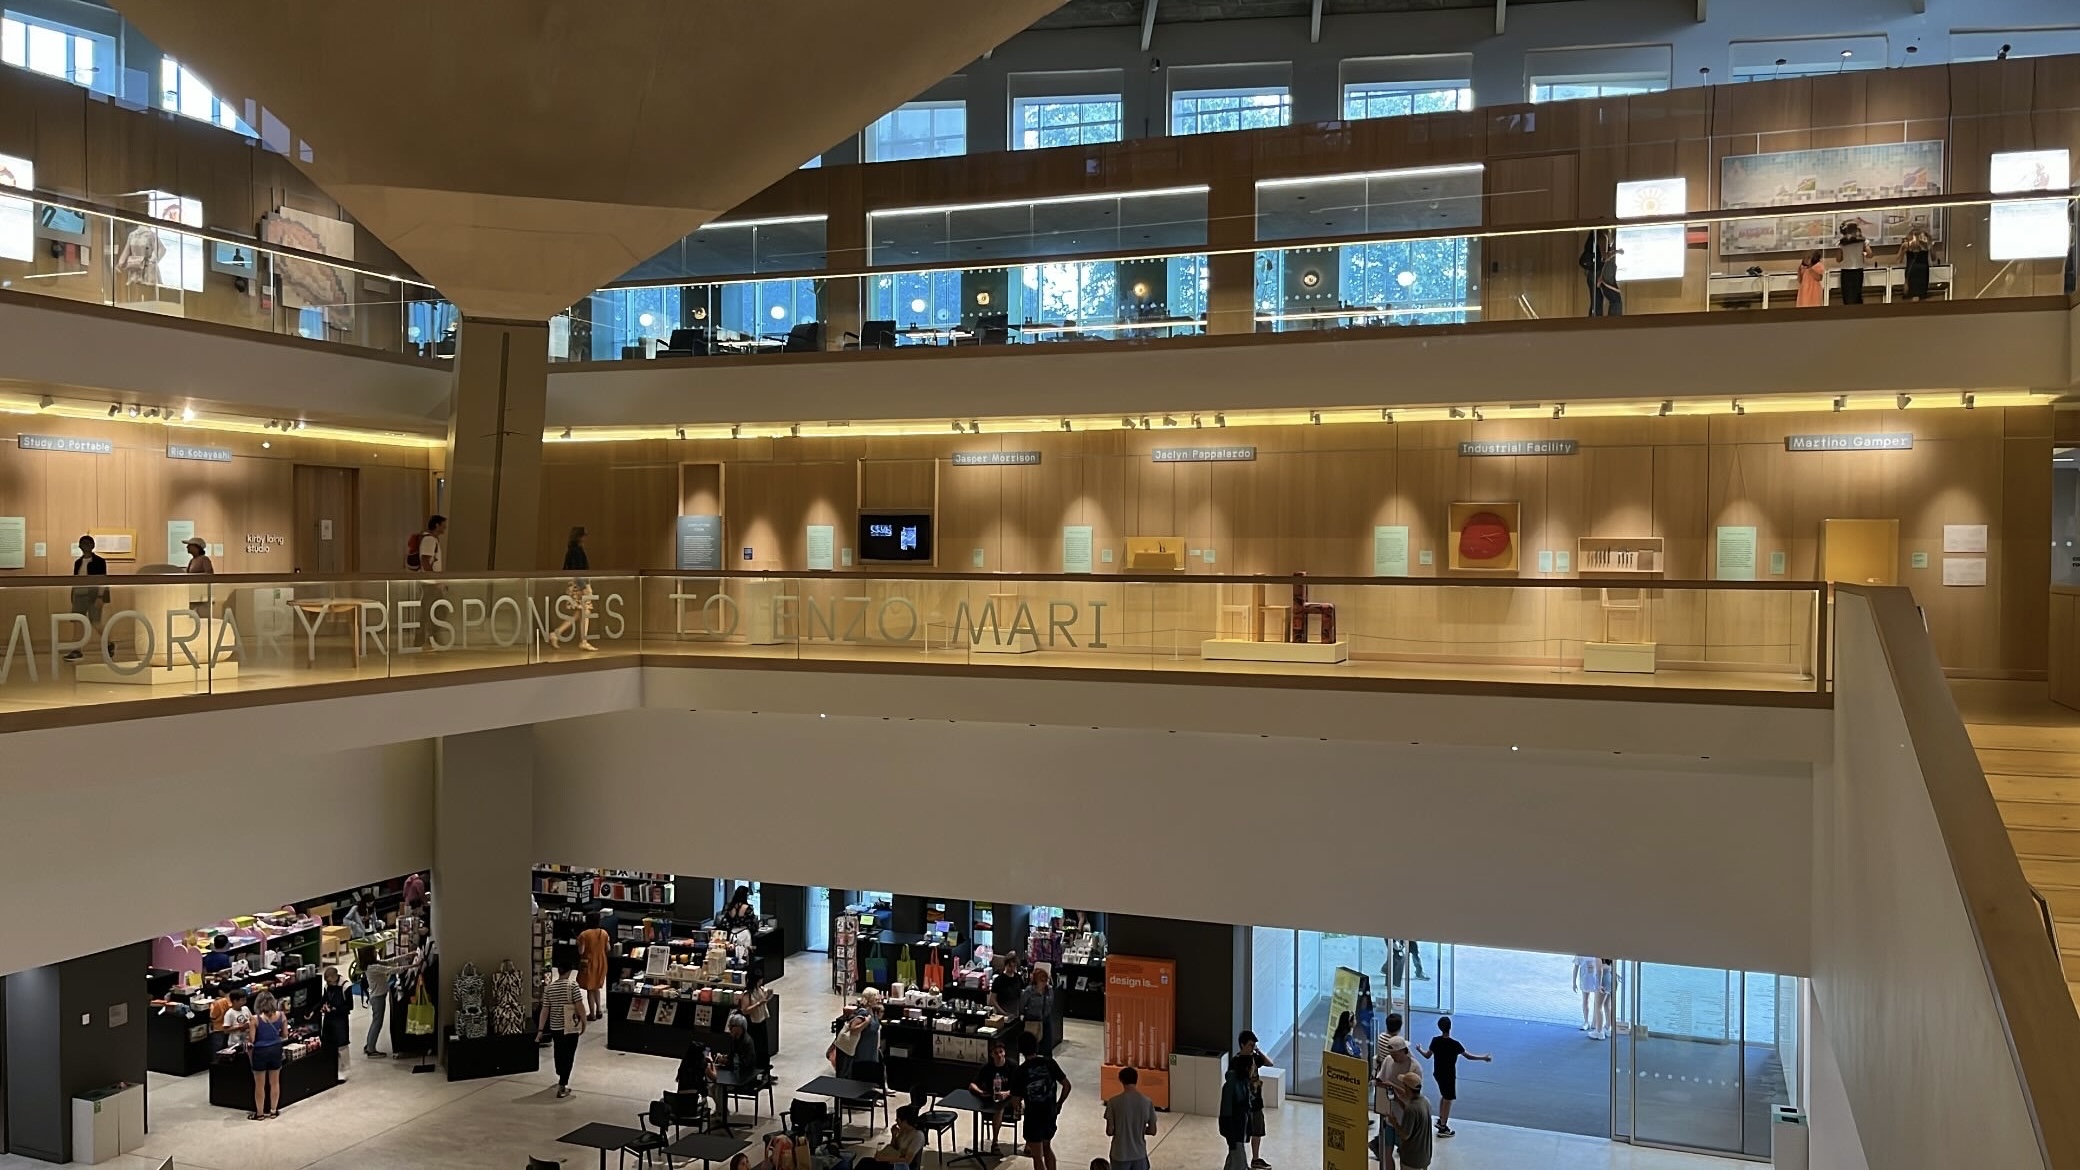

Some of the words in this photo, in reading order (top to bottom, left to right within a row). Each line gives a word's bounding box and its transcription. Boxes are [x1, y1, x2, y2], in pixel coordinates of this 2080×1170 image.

[23, 437, 52, 449] Study
[57, 440, 65, 448] O
[68, 440, 110, 451] Portable
[1463, 443, 1521, 453] Industrial
[1527, 442, 1571, 453] Facility
[1793, 437, 1847, 448] Martino
[1853, 436, 1906, 448] Gamper
[170, 446, 185, 457] Rio
[187, 448, 230, 460] Kobayashi
[954, 454, 988, 464] Jasper
[991, 453, 1036, 463] Morrison
[1155, 450, 1188, 460] Jaclyn
[1192, 449, 1251, 460] Pappalardo
[246, 533, 266, 546] kirby
[246, 544, 270, 553] studio
[360, 593, 625, 658] RESPONSES
[669, 593, 739, 640] TO
[774, 596, 917, 643] ENZO
[952, 600, 1108, 649] MARI
[1109, 975, 1140, 988] design
